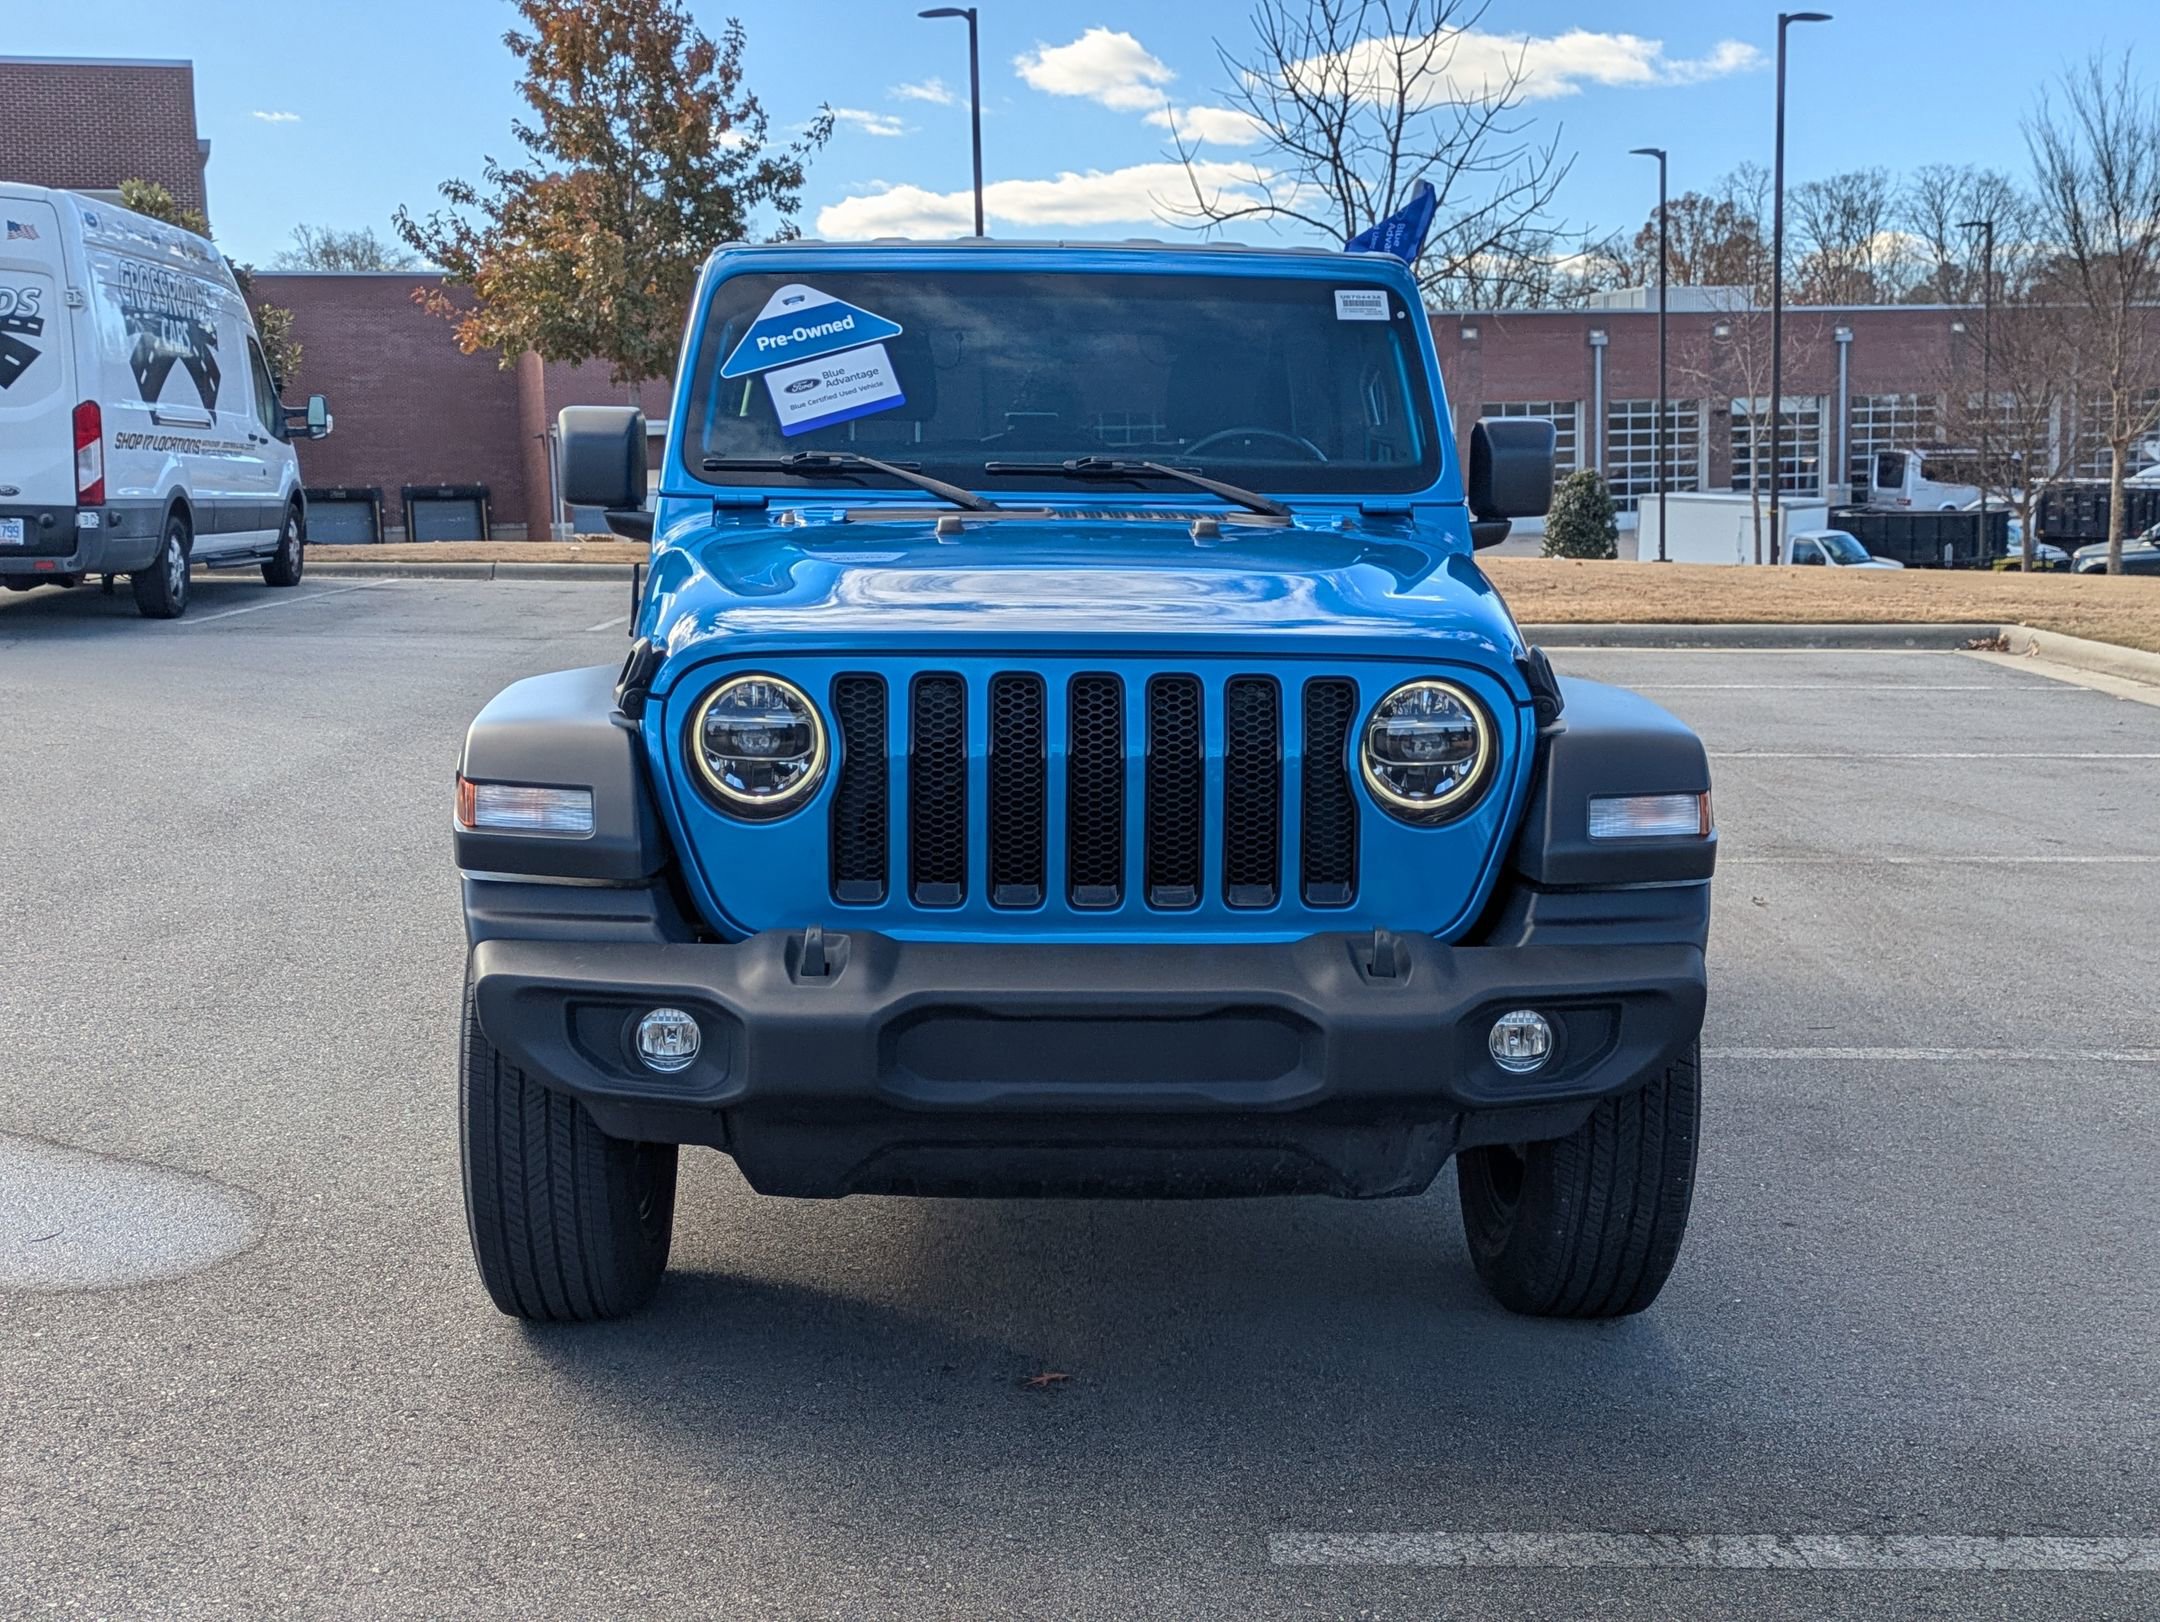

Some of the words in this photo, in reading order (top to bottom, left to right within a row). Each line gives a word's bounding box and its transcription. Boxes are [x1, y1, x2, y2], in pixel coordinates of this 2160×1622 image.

[1393, 223, 1406, 247] Blue
[161, 317, 191, 353] CARS
[756, 314, 855, 351] Pre-Owned
[822, 368, 845, 380] Blue
[826, 368, 880, 388] Advantage
[790, 402, 806, 411] Blue
[807, 393, 838, 406] Certified
[838, 388, 857, 397] Used
[857, 381, 884, 391] Vehicle
[791, 380, 814, 393] Ford
[115, 432, 143, 450] SHOP
[143, 435, 154, 450] 17
[153, 435, 202, 454] LOCATIONS
